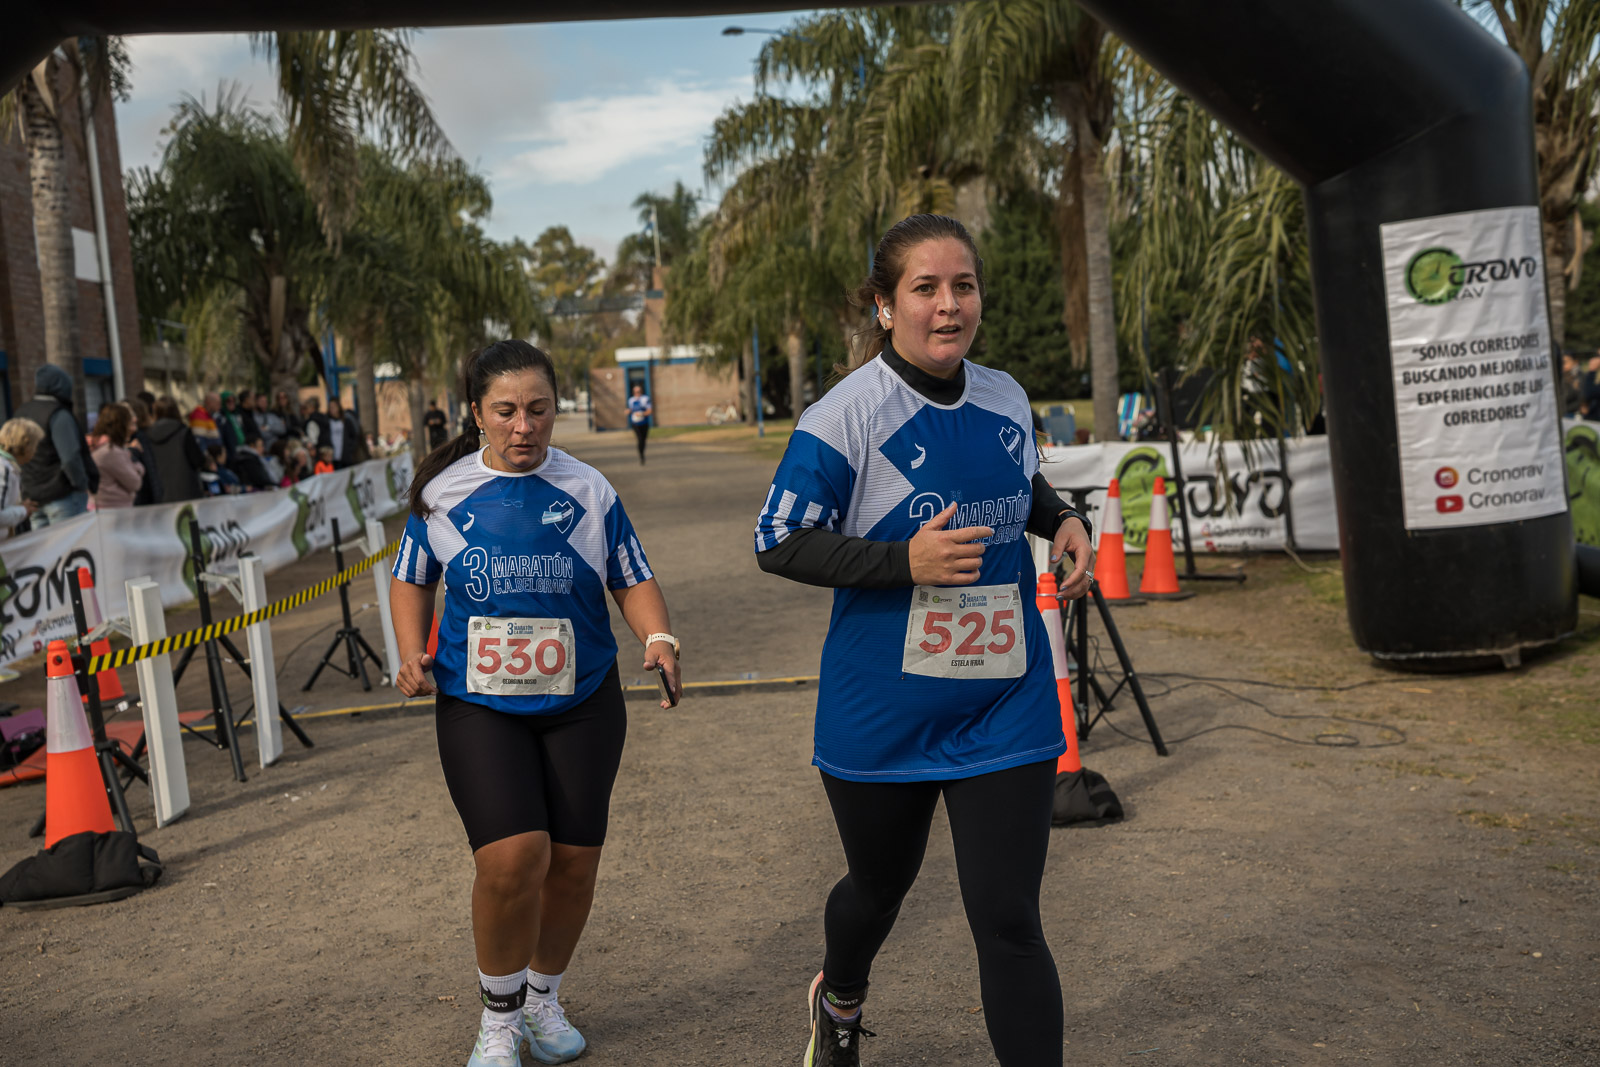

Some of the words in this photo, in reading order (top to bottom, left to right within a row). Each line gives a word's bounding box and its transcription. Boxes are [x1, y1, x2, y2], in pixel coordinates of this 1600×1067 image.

[1402, 363, 1478, 386] BUSCANDO
[1480, 356, 1533, 378] MEJORAR
[1417, 382, 1511, 407] EXPERIENCIAS
[1512, 379, 1527, 397] DE
[1467, 463, 1545, 485] Cronorav
[1468, 487, 1547, 509] Cronorav
[462, 546, 491, 602] 3
[491, 551, 574, 579] MARATÓN
[959, 593, 967, 609] 3
[507, 622, 514, 635] 3
[919, 609, 1016, 655] 525
[476, 637, 566, 676] 530
[951, 659, 969, 667] ESTELA
